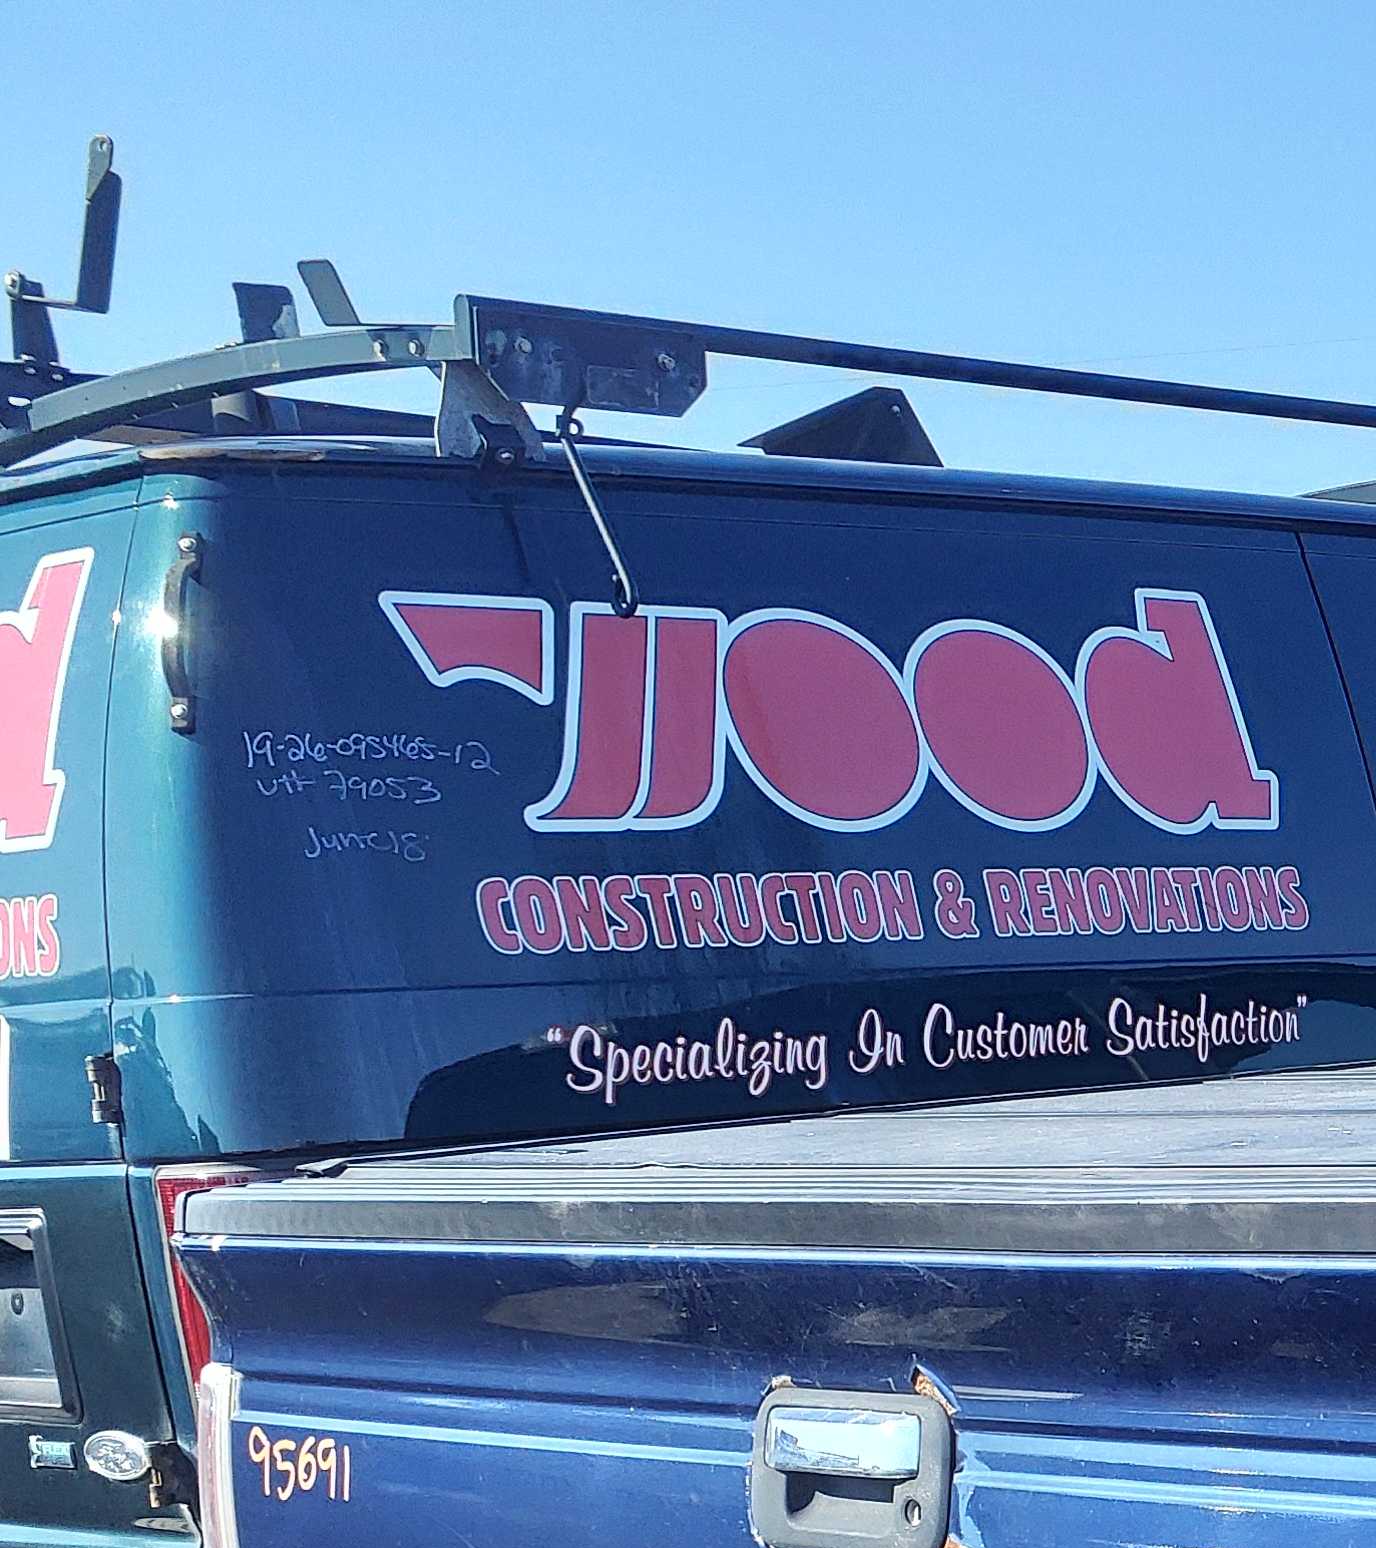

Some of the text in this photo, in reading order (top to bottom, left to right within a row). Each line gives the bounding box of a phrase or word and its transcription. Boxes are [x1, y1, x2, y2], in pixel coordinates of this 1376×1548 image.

[323, 770, 442, 804] 79053
[477, 866, 1309, 955] CONSTRUCTION & RENOVATIONS
[849, 1008, 904, 1073] In
[923, 1003, 1090, 1069] Customer
[249, 1425, 350, 1502] 95691
